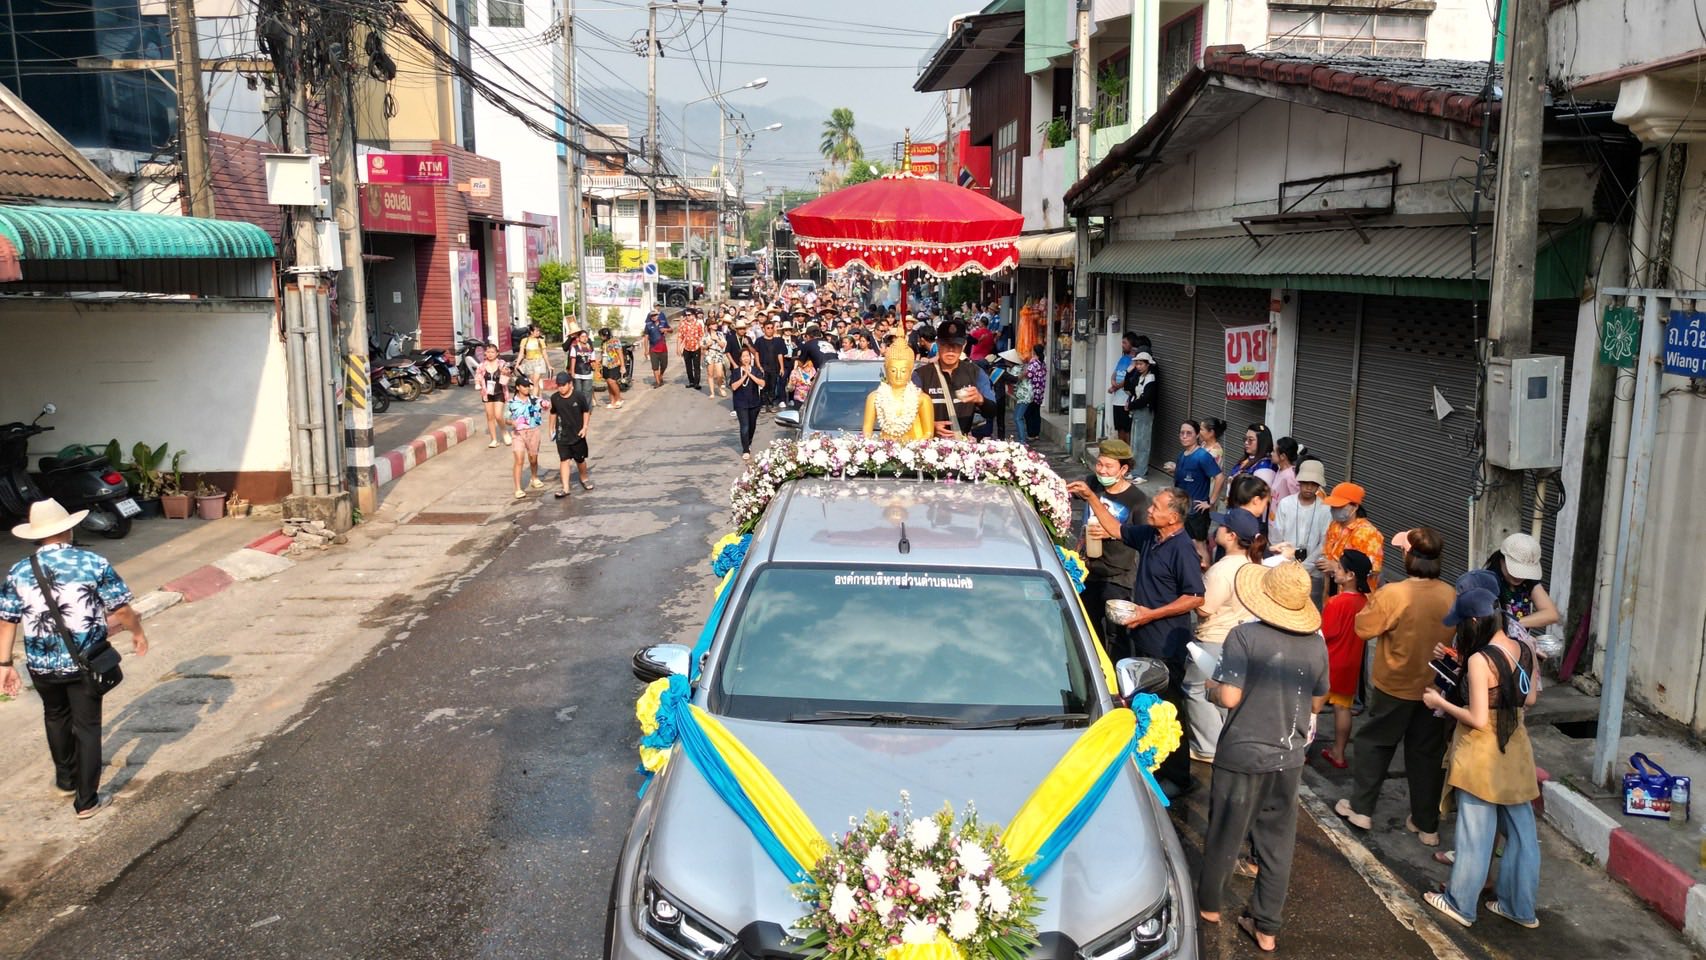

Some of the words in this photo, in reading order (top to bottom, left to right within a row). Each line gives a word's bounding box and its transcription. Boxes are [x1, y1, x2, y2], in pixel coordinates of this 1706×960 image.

[419, 161, 442, 172] ATM
[1227, 329, 1268, 364] ขาย
[1666, 351, 1699, 373] Wiang
